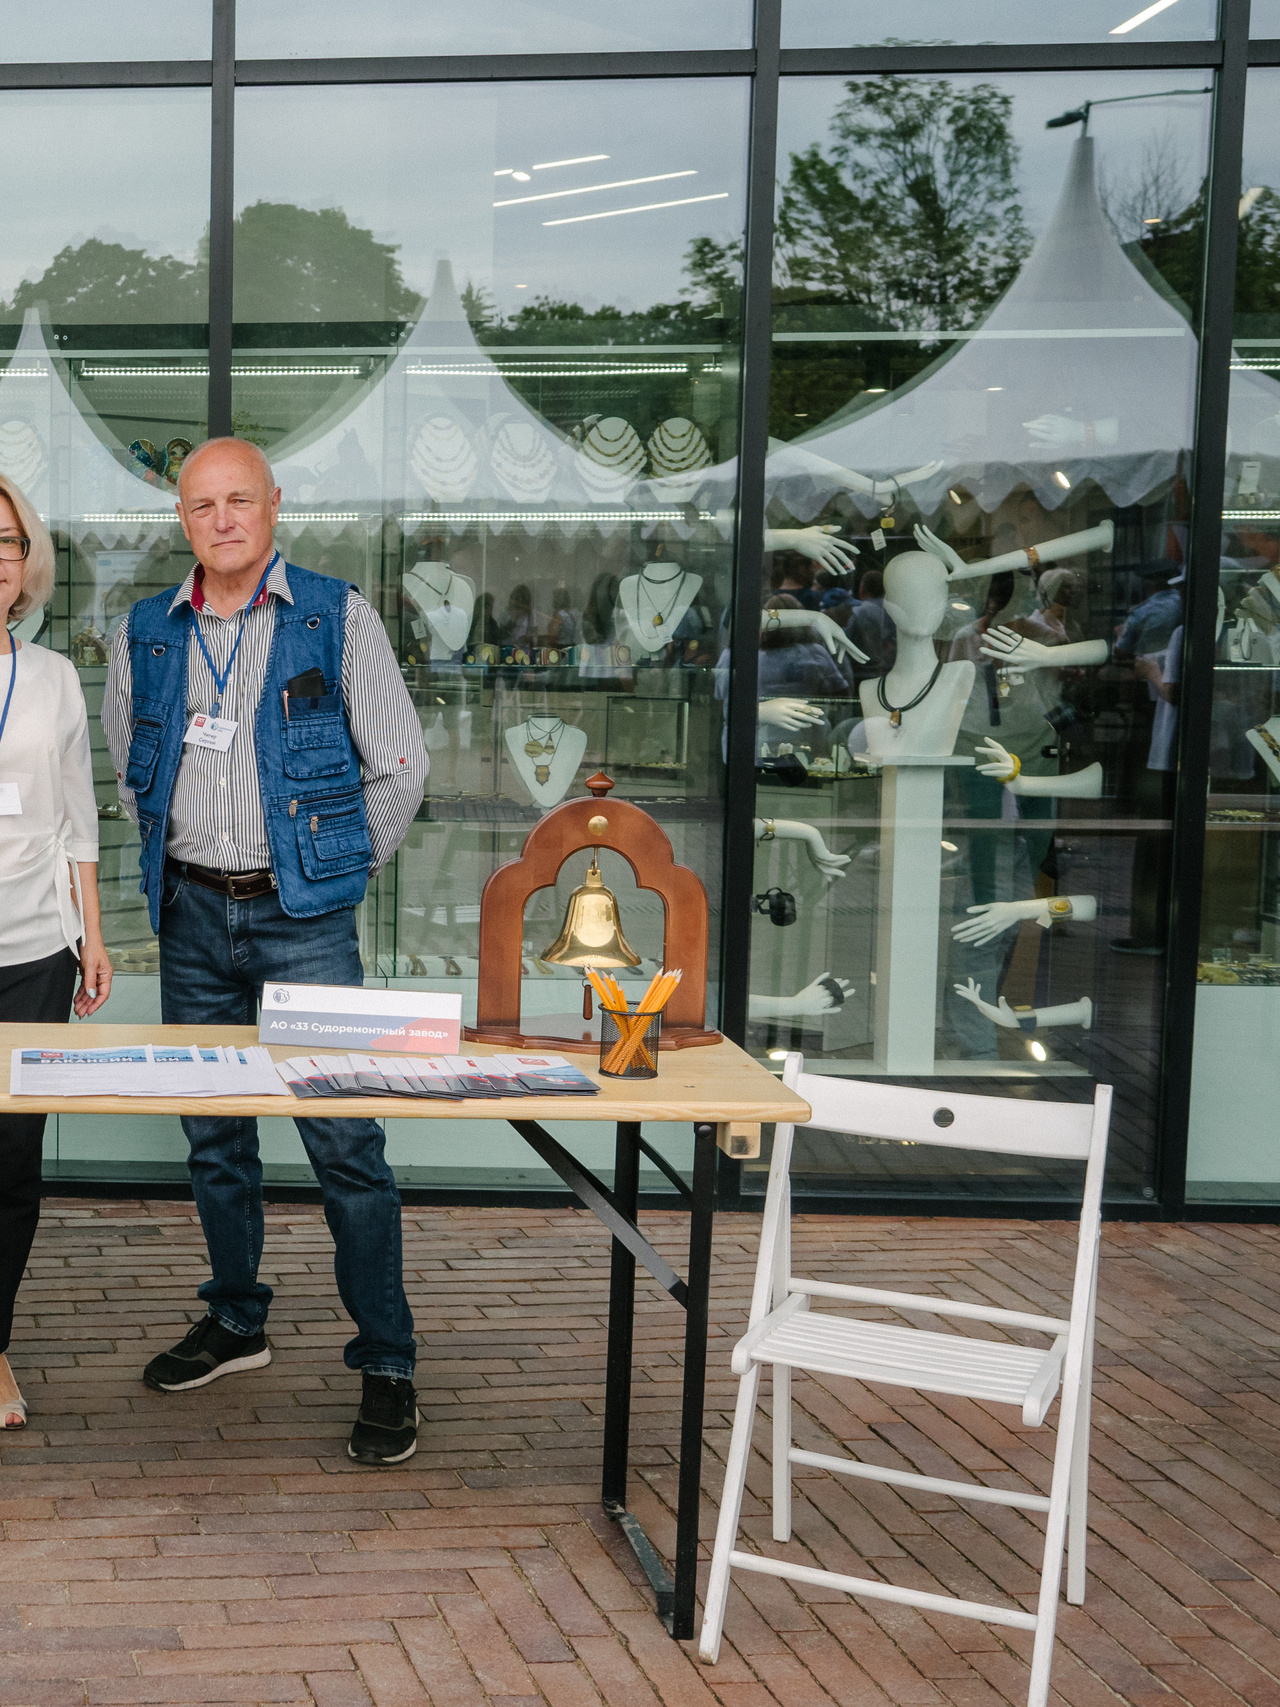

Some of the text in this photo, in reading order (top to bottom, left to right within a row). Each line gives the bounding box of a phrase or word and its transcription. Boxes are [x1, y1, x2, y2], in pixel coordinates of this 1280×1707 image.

[270, 1020, 449, 1040] АО «33 Судоремонтный завод»
